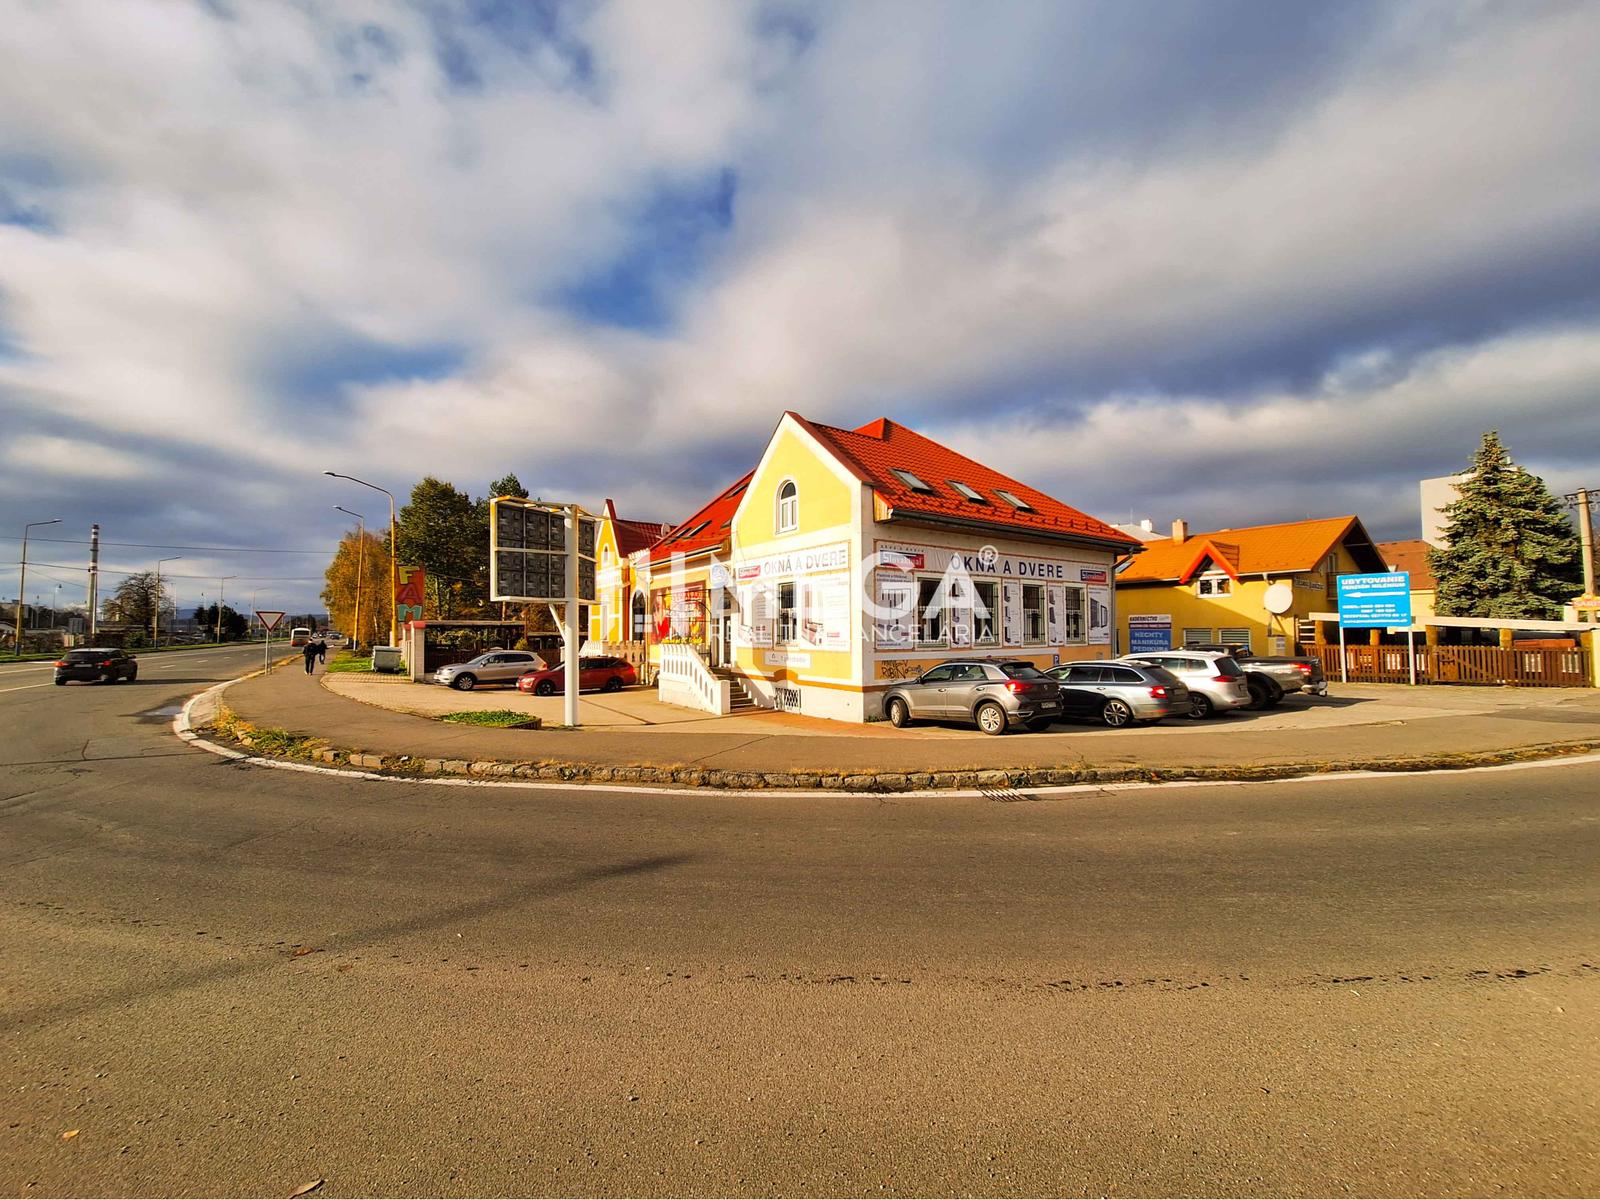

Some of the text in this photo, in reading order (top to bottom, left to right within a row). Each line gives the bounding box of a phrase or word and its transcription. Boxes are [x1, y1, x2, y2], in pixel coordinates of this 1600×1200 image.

[1003, 560, 1012, 574] A
[1019, 562, 1063, 578] DVERE
[1341, 576, 1405, 585] UBYTOVANIE
